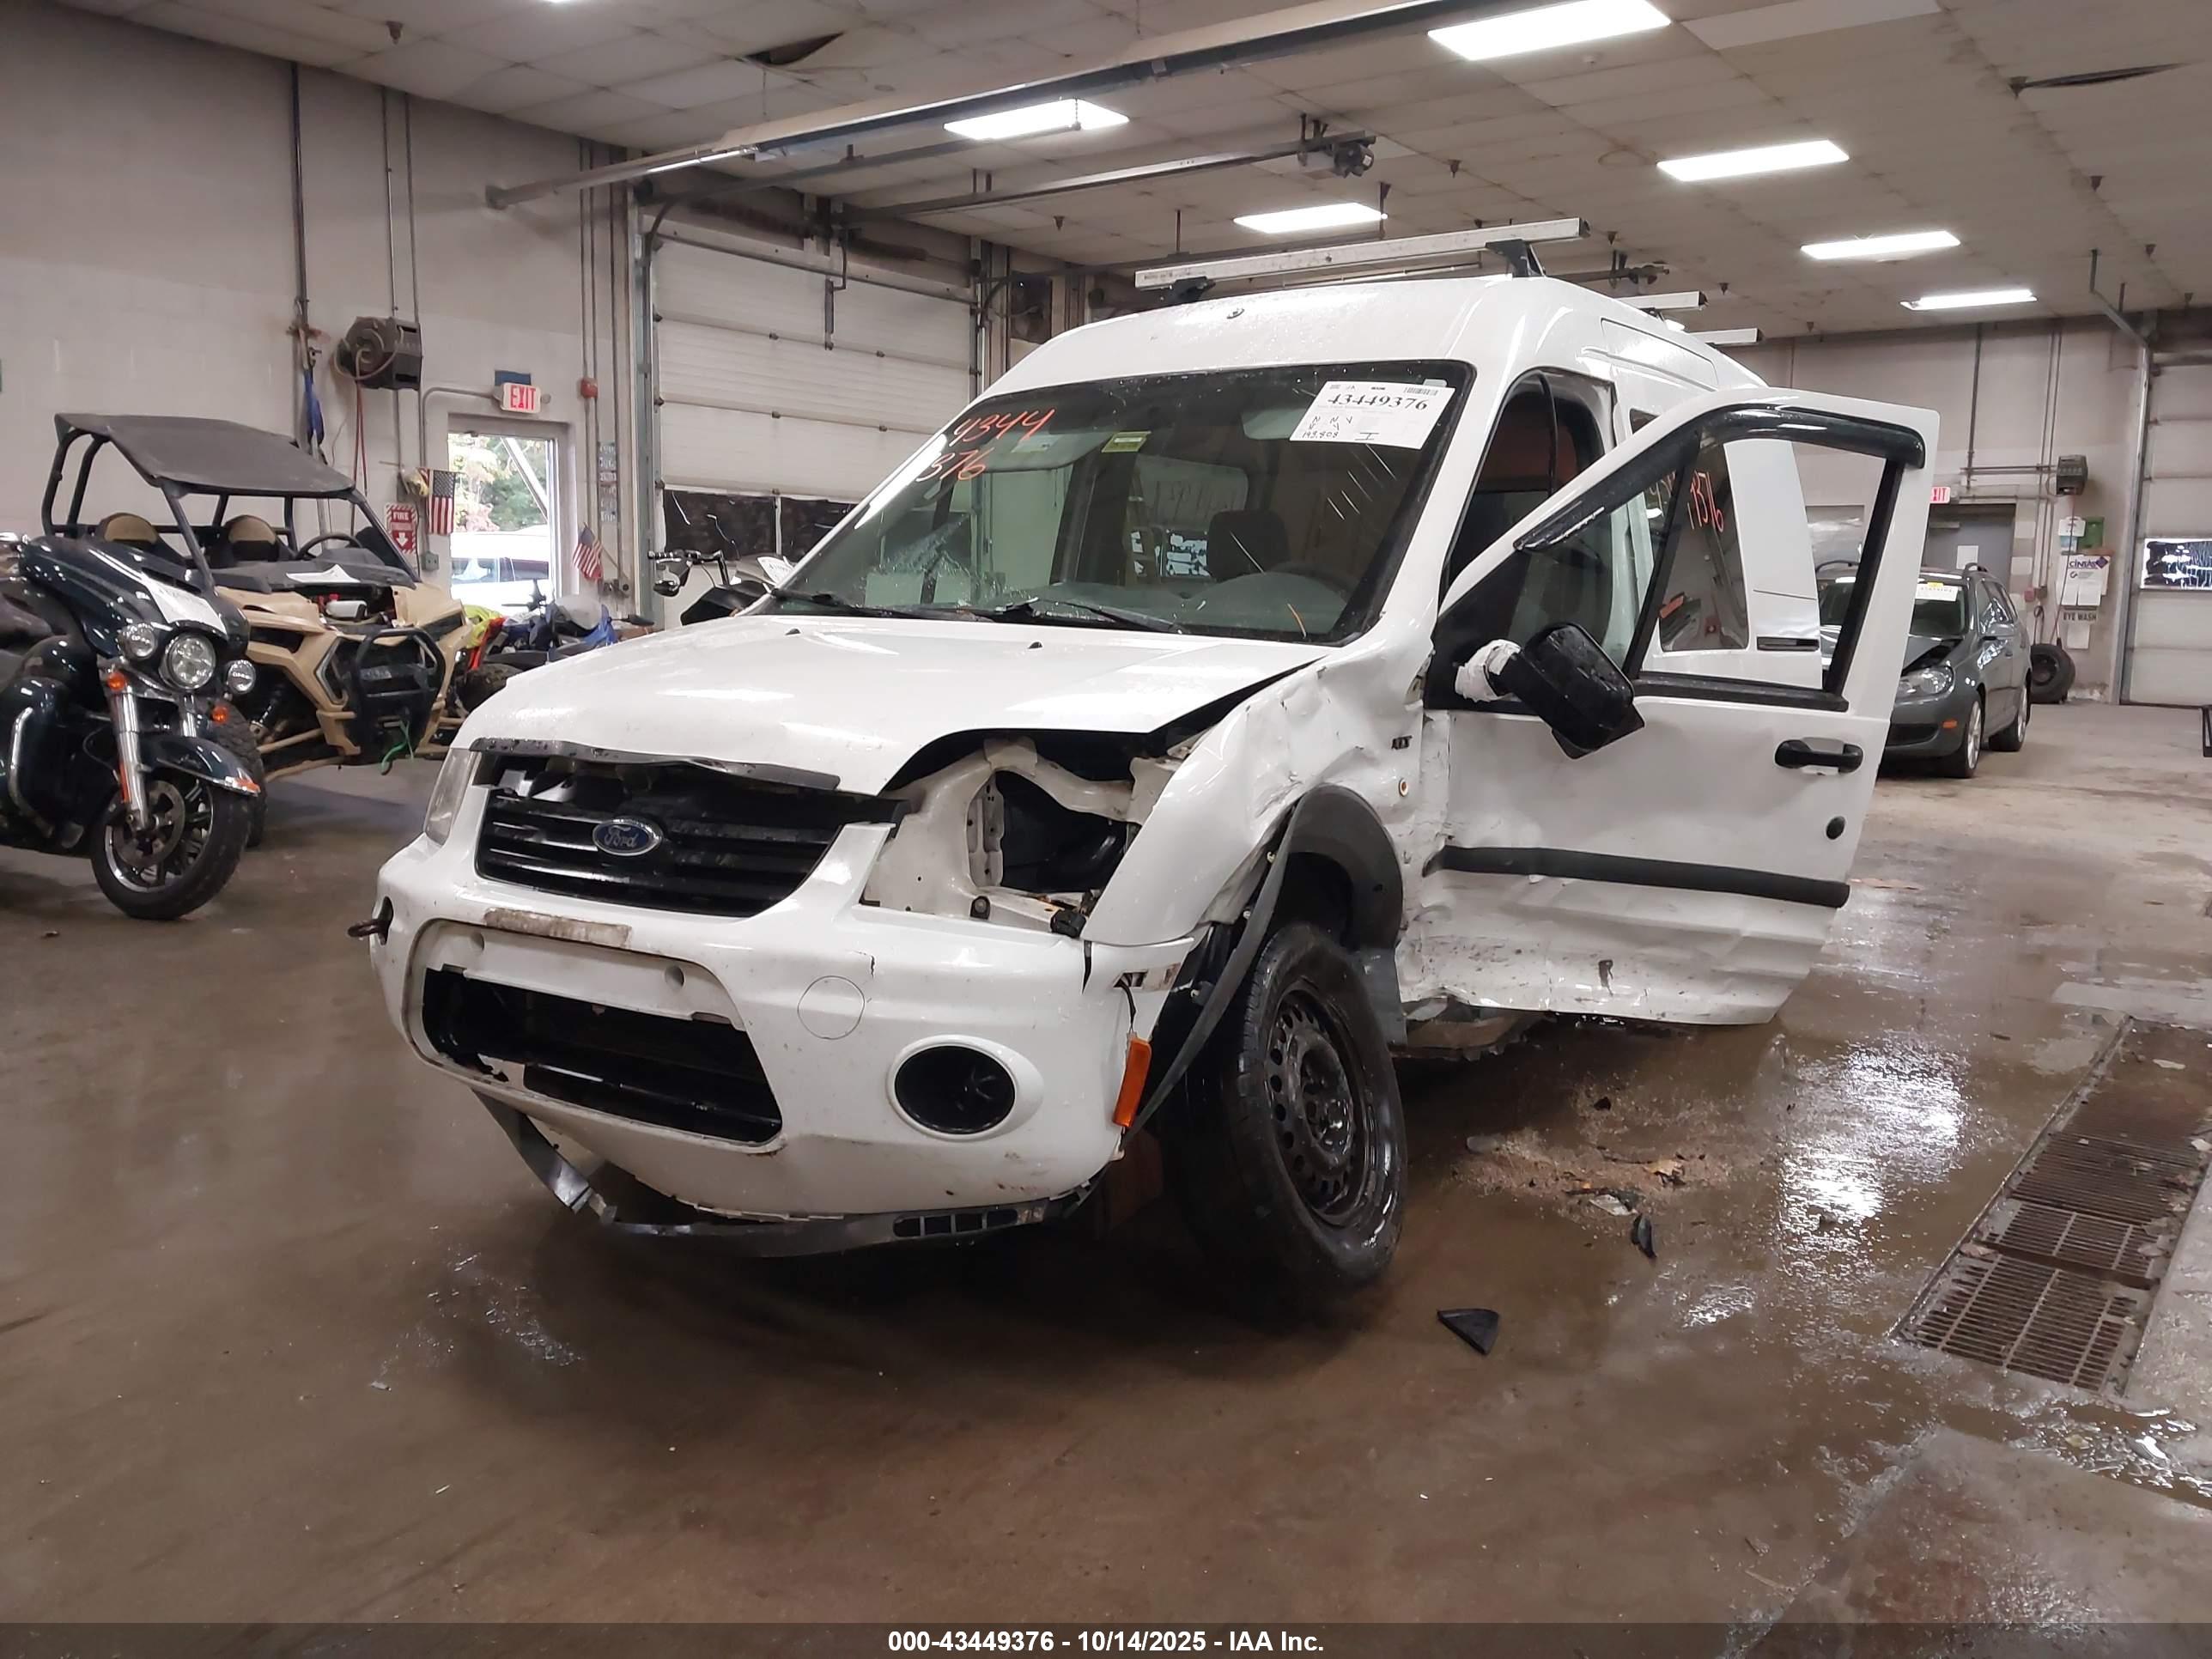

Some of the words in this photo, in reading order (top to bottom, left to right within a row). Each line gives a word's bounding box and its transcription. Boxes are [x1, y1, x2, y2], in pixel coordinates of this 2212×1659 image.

[510, 385, 536, 410] EXIT
[1327, 393, 1429, 410] 43449376
[949, 409, 1055, 447] 4344
[1932, 487, 1947, 501] XIT
[392, 511, 410, 520] FIRE
[2063, 611, 2076, 621] EYE
[2078, 611, 2096, 622] WASH
[604, 824, 639, 848] Ford
